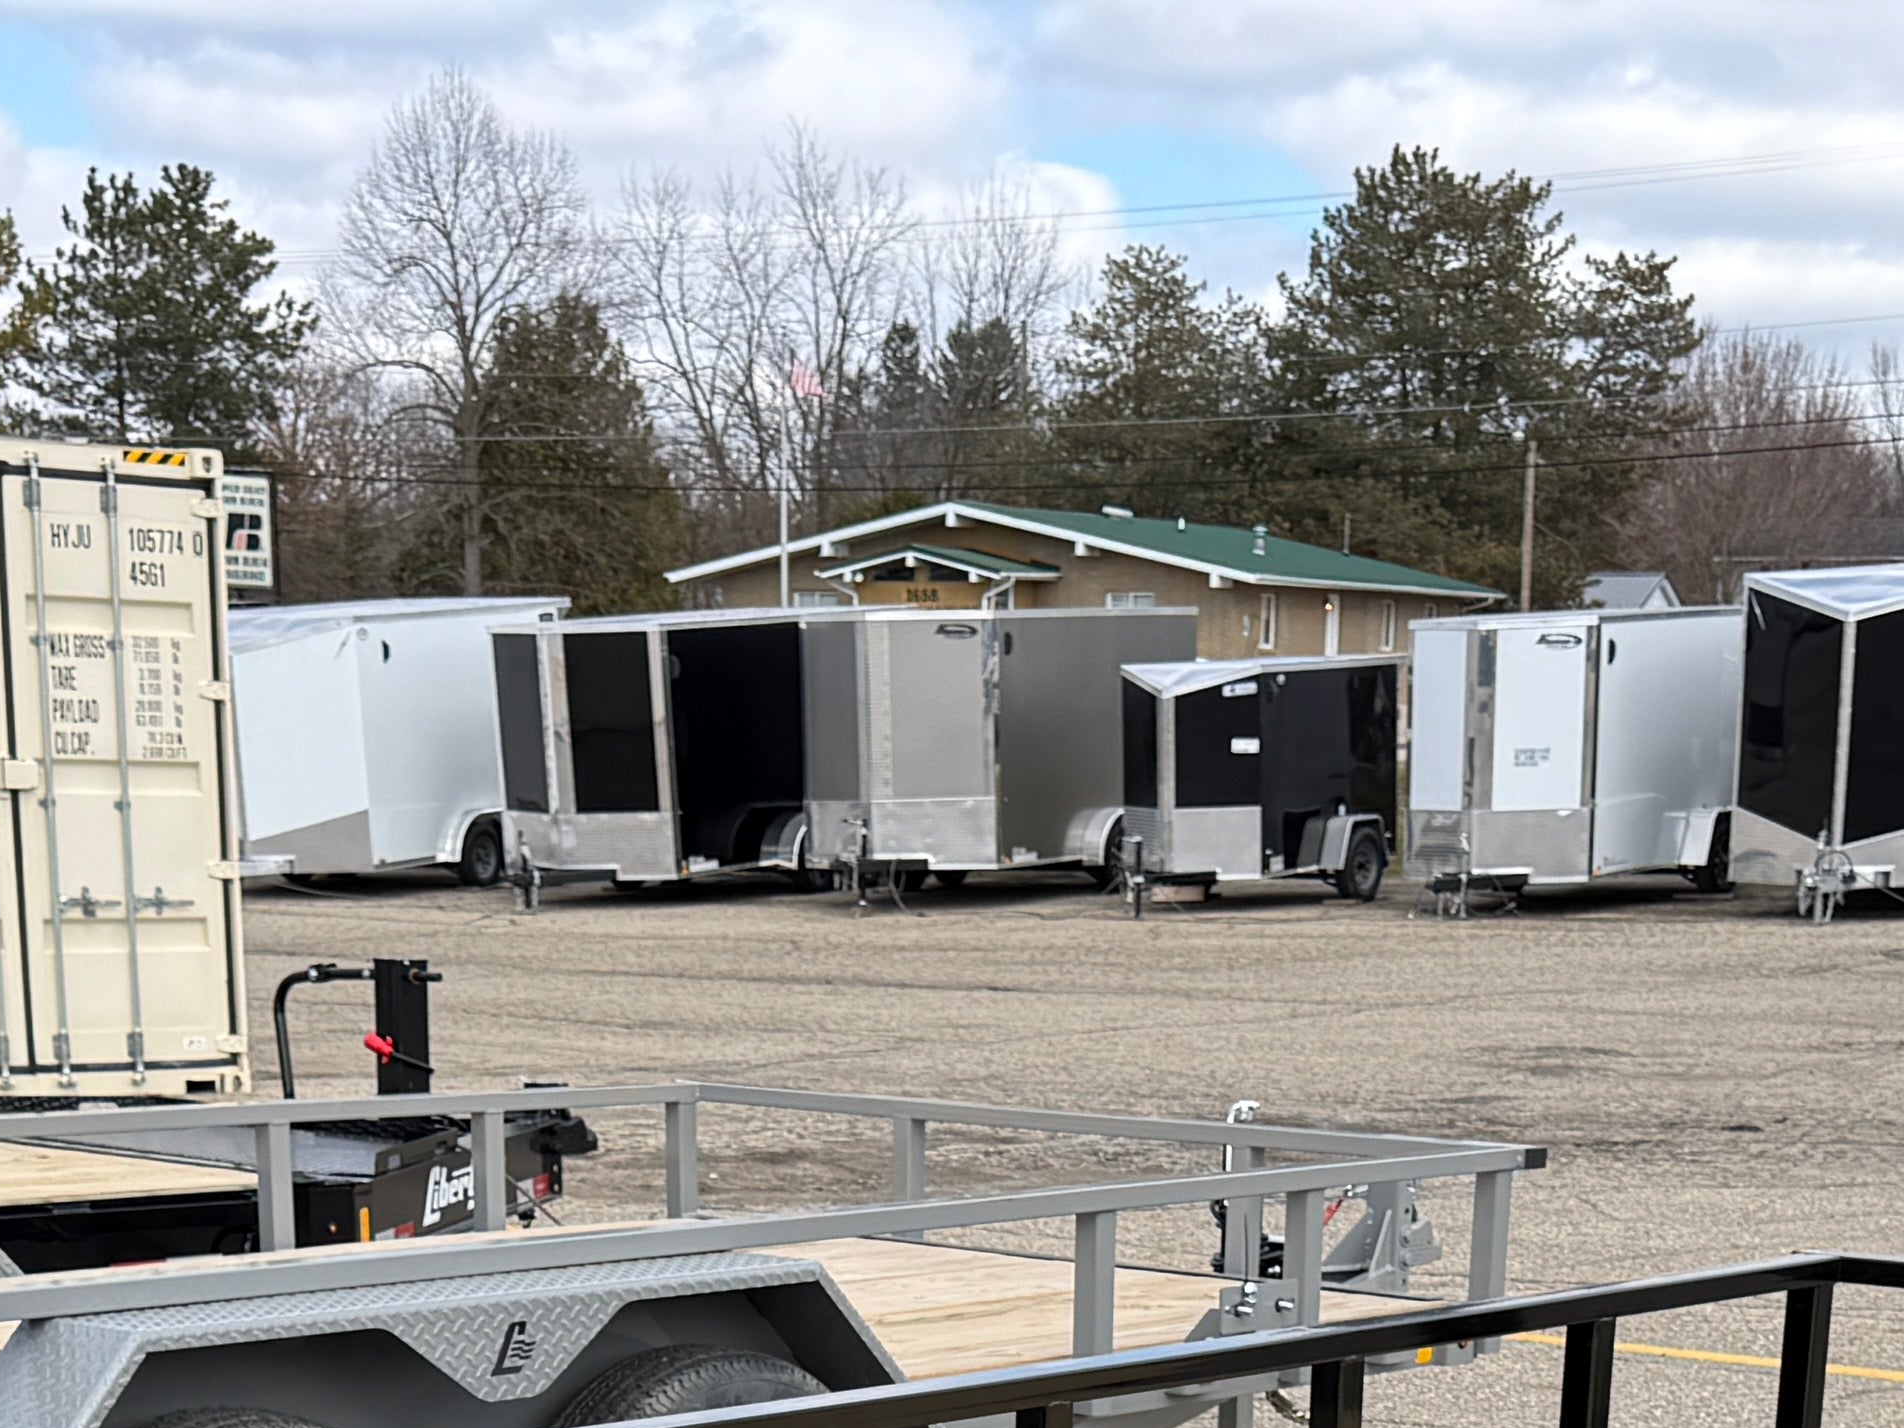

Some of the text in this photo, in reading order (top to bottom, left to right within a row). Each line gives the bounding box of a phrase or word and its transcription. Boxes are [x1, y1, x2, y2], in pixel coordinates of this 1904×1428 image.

[50, 523, 91, 549] HYJU
[128, 527, 184, 554] 105774
[53, 698, 100, 723] PAYLOAD
